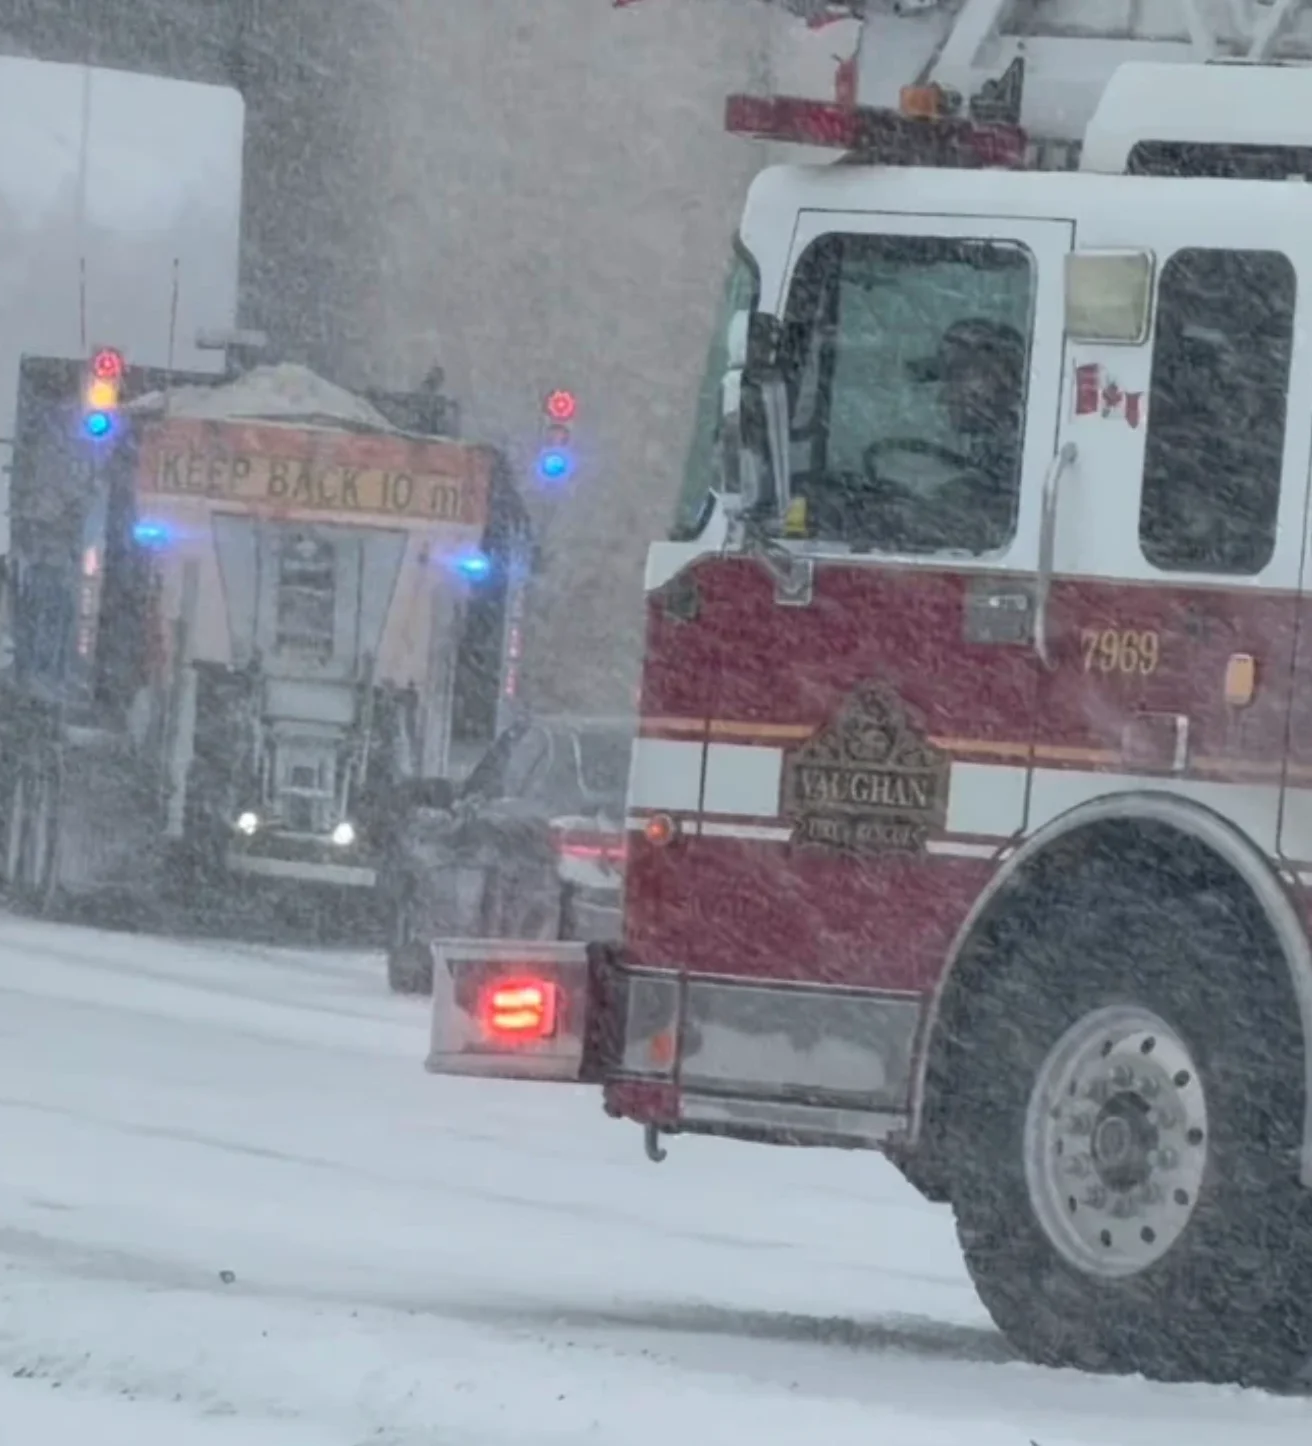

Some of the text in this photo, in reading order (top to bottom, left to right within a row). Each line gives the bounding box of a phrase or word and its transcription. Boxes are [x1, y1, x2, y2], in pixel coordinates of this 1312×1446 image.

[160, 447, 250, 491] KEEP
[267, 462, 360, 509] BACK
[380, 471, 414, 512] 10
[1080, 628, 1158, 675] 7969
[800, 768, 927, 807] VAUGHAN
